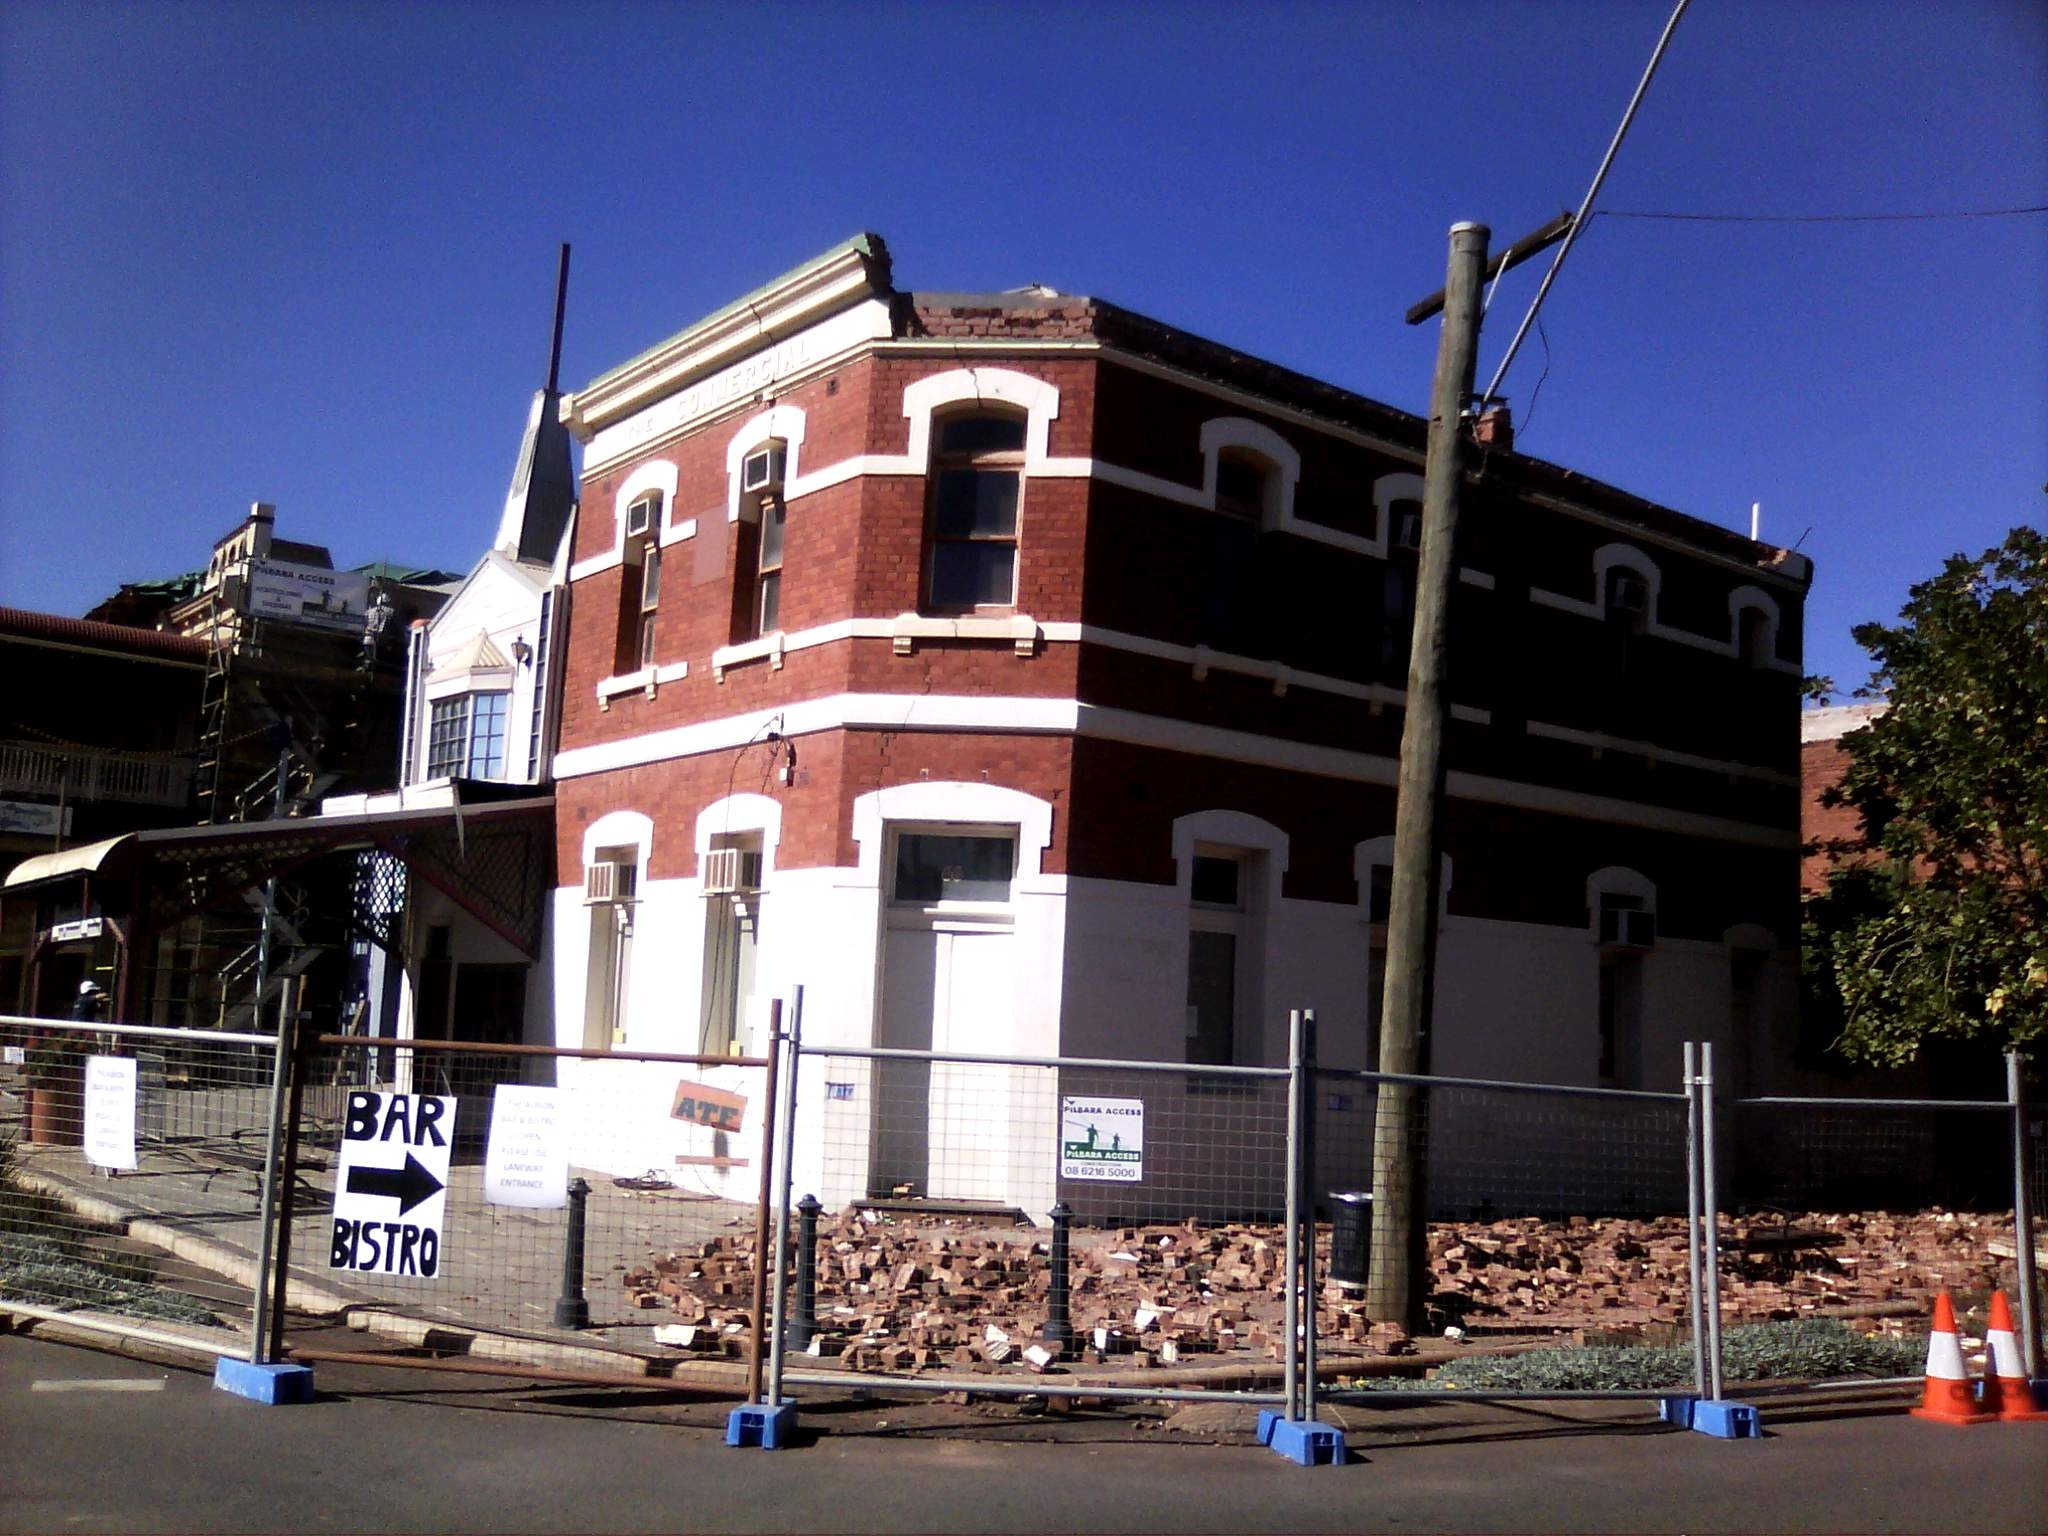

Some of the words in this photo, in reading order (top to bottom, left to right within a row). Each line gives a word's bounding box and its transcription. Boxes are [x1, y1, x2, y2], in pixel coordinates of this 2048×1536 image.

[678, 339, 811, 421] COMMERCIAL
[344, 1091, 448, 1147] BAR
[1106, 1107, 1142, 1116] ACCESS
[1065, 1166, 1079, 1175] 08
[1081, 1166, 1105, 1176] 6216
[1107, 1167, 1136, 1177] 5000
[1105, 1151, 1140, 1161] ACCESS
[330, 1217, 439, 1277] BISTRO
